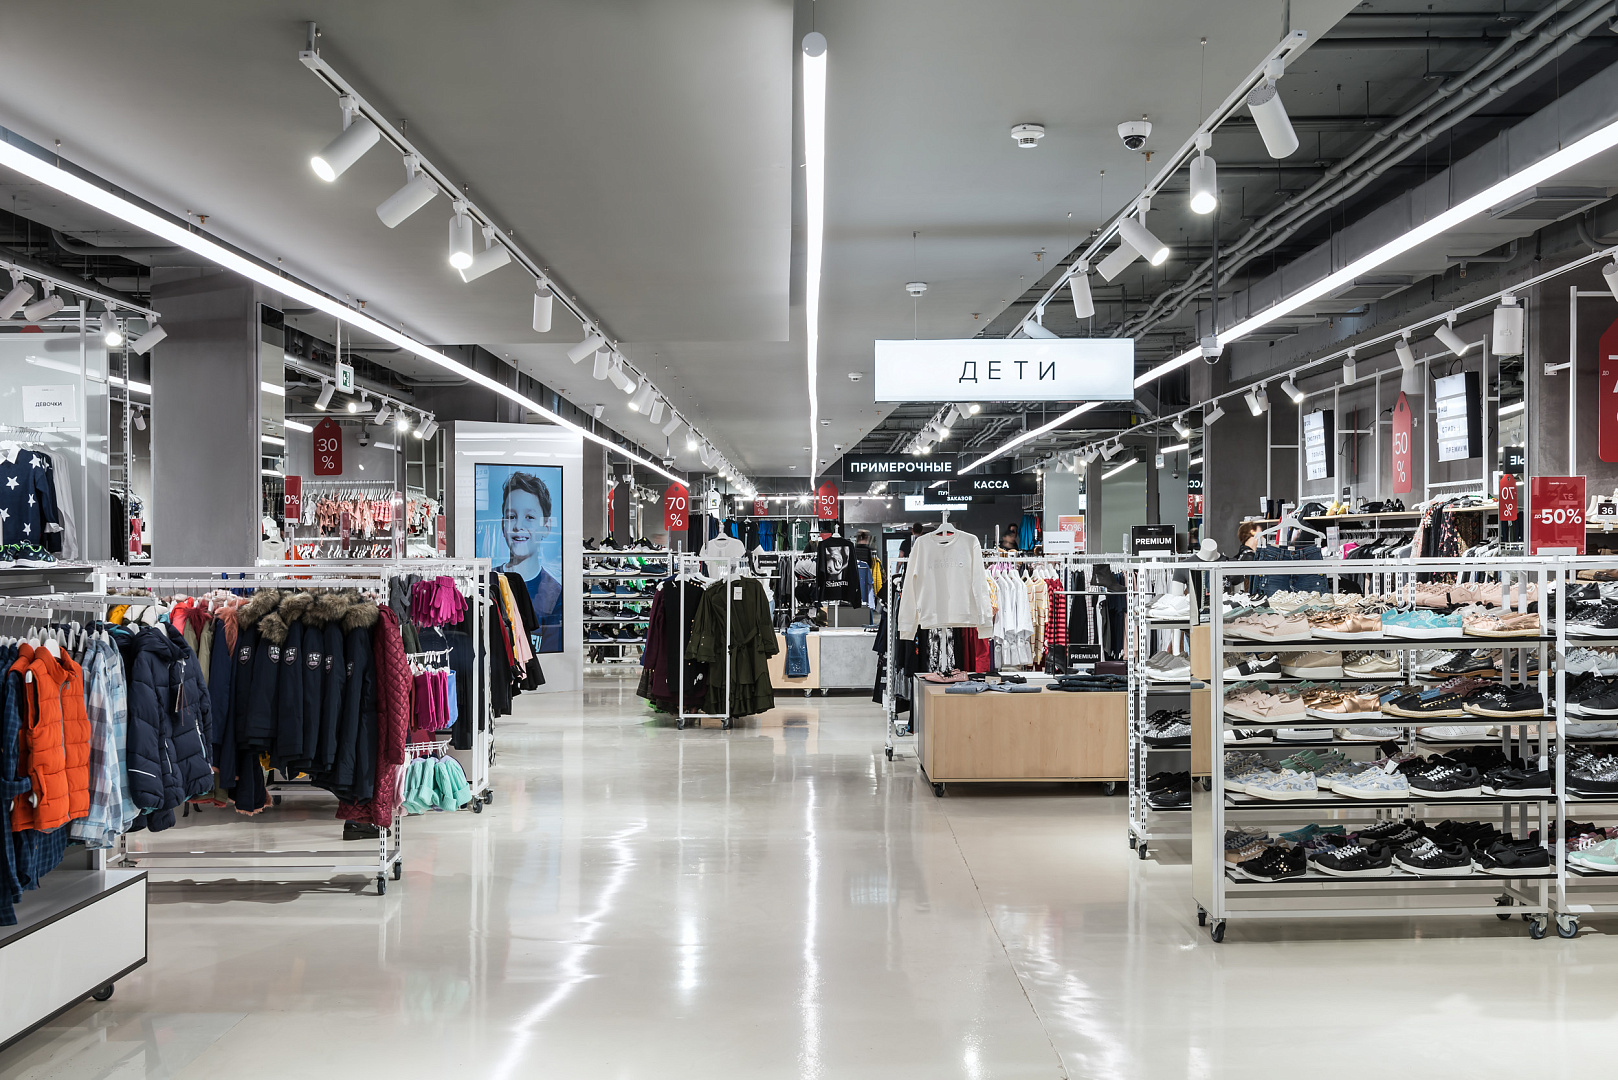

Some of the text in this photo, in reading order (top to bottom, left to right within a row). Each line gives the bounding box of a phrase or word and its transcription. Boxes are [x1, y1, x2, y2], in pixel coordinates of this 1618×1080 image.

[959, 360, 1055, 384] ДЕТИ
[321, 455, 335, 469] %
[850, 462, 952, 473] ПРИМЕРОЧНЫЕ
[1396, 460, 1406, 483] %
[974, 480, 1010, 489] КАССА
[823, 505, 833, 515] %
[1601, 507, 1614, 515] 36
[670, 513, 683, 527] %
[1135, 537, 1173, 545] PREMIUM
